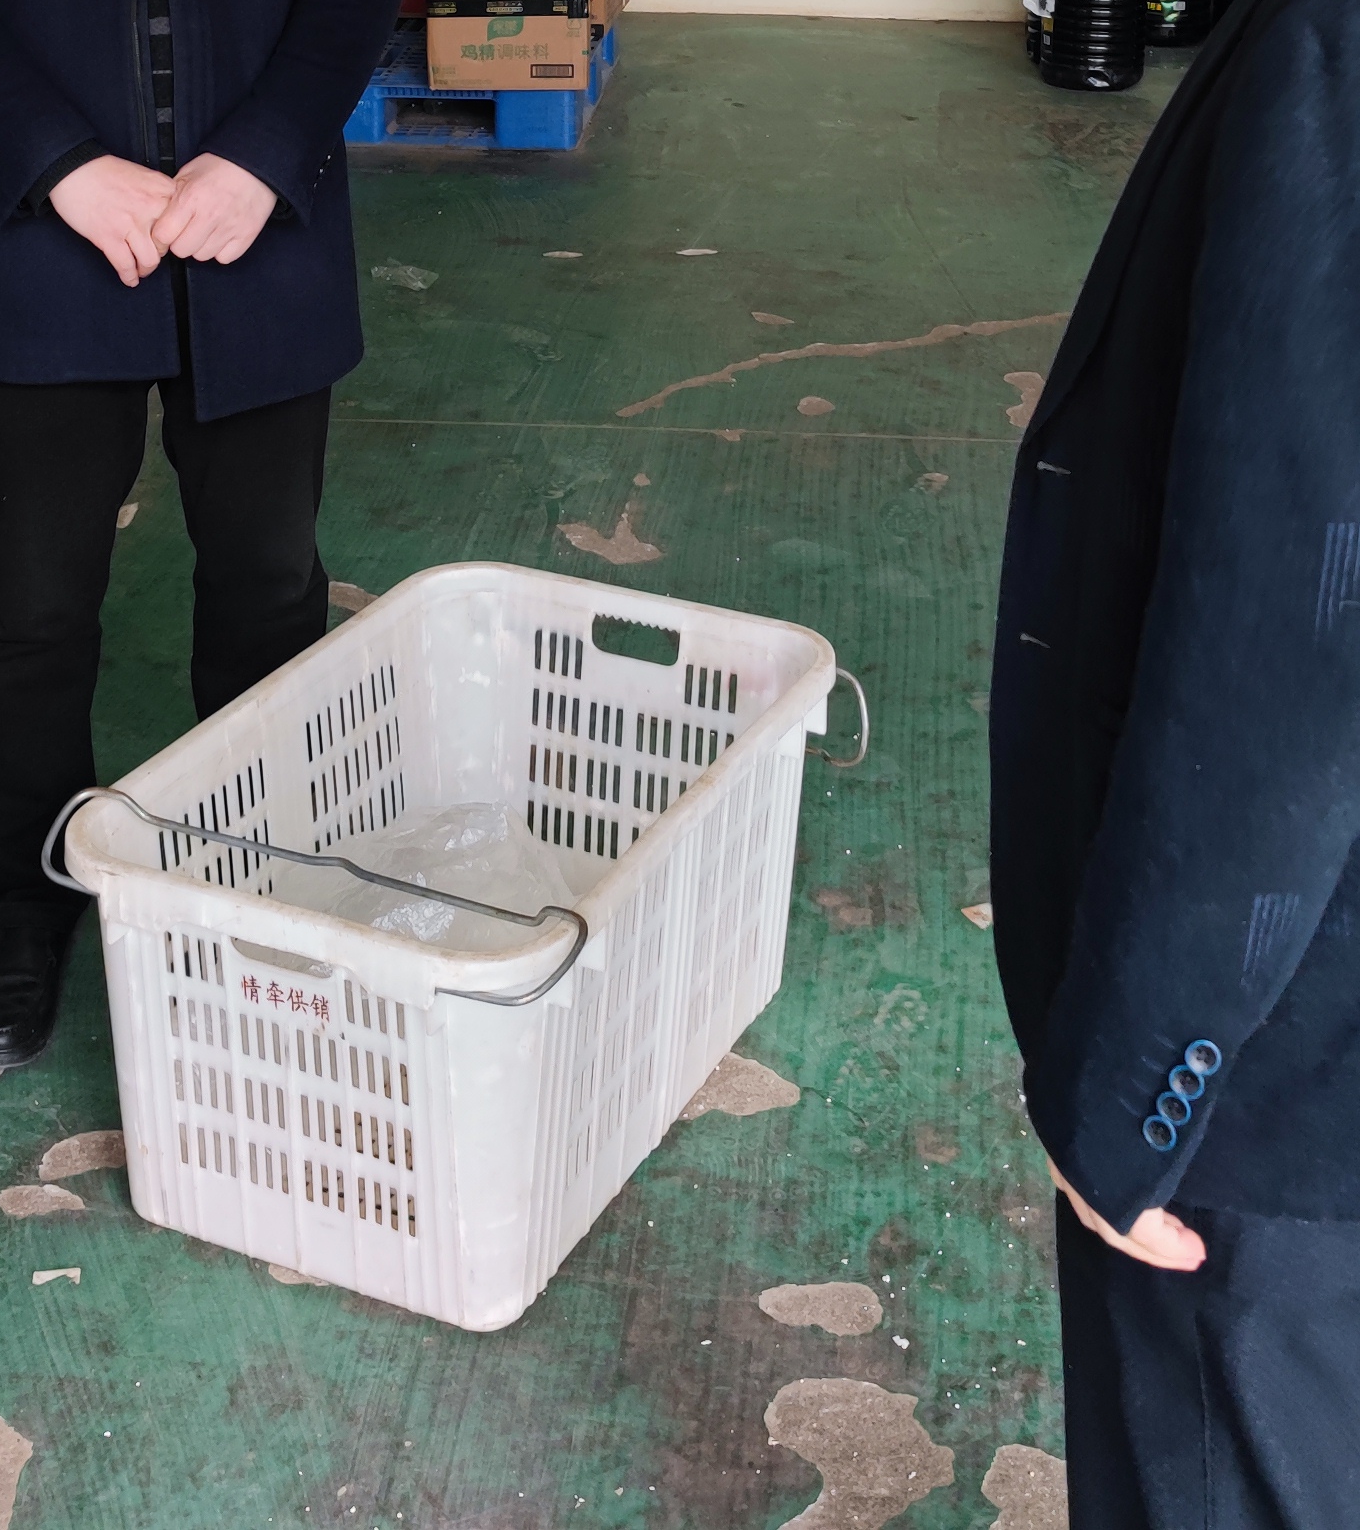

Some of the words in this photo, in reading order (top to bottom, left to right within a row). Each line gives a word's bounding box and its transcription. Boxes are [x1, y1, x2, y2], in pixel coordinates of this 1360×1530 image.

[460, 43, 549, 61] 鸡精调味料
[241, 975, 330, 1022] 情牵供销
